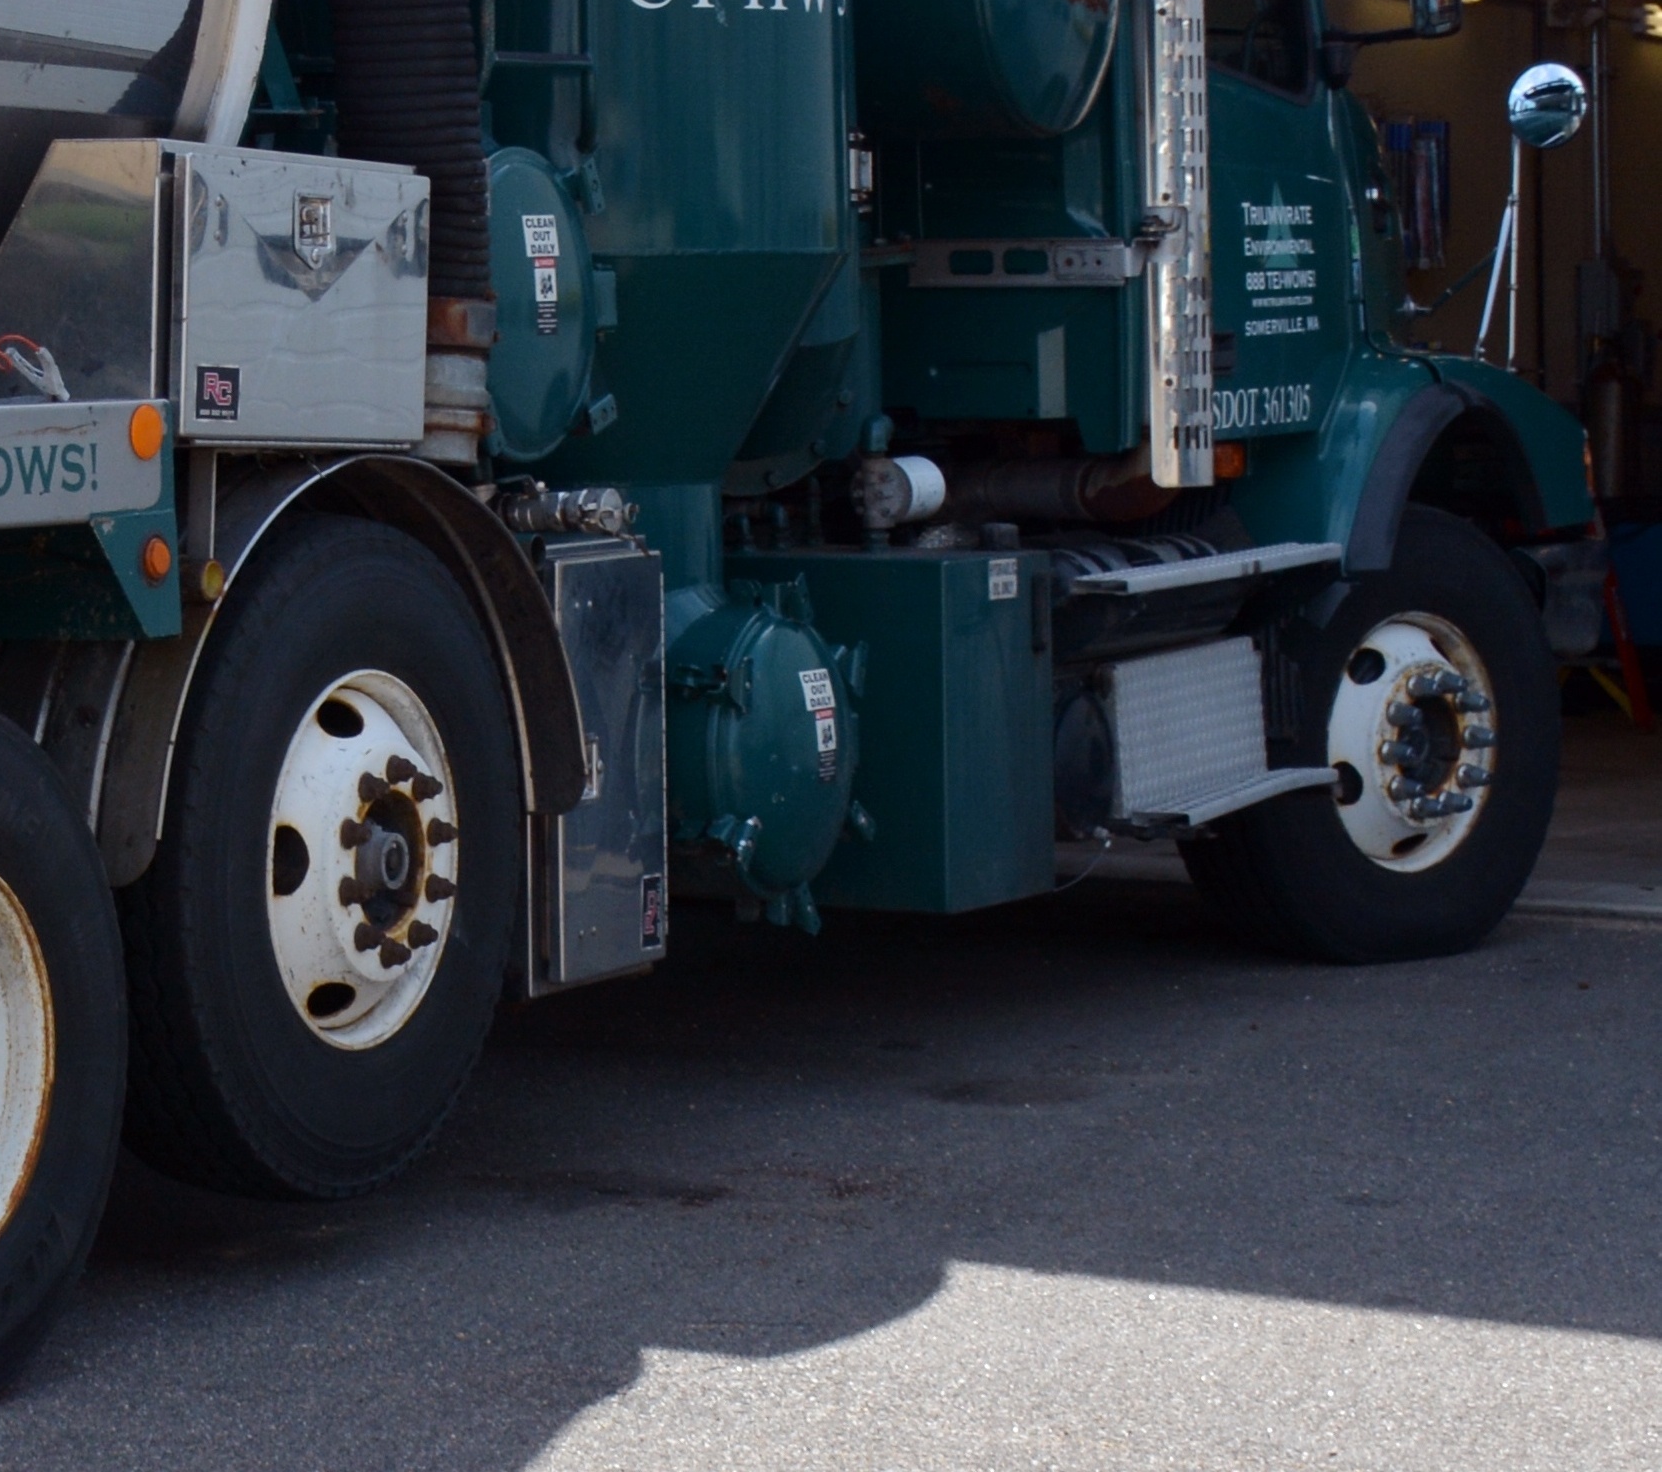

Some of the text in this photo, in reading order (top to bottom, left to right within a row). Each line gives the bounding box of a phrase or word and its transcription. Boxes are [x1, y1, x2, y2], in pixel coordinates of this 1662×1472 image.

[1241, 202, 1313, 226] TRIUMVIRATE
[525, 218, 554, 228] CLEAN
[532, 231, 551, 241] OUT
[530, 244, 555, 254] DAILY
[1245, 272, 1266, 290] 888
[1212, 384, 1311, 430] SDOT 361305
[811, 684, 827, 695] OUT
